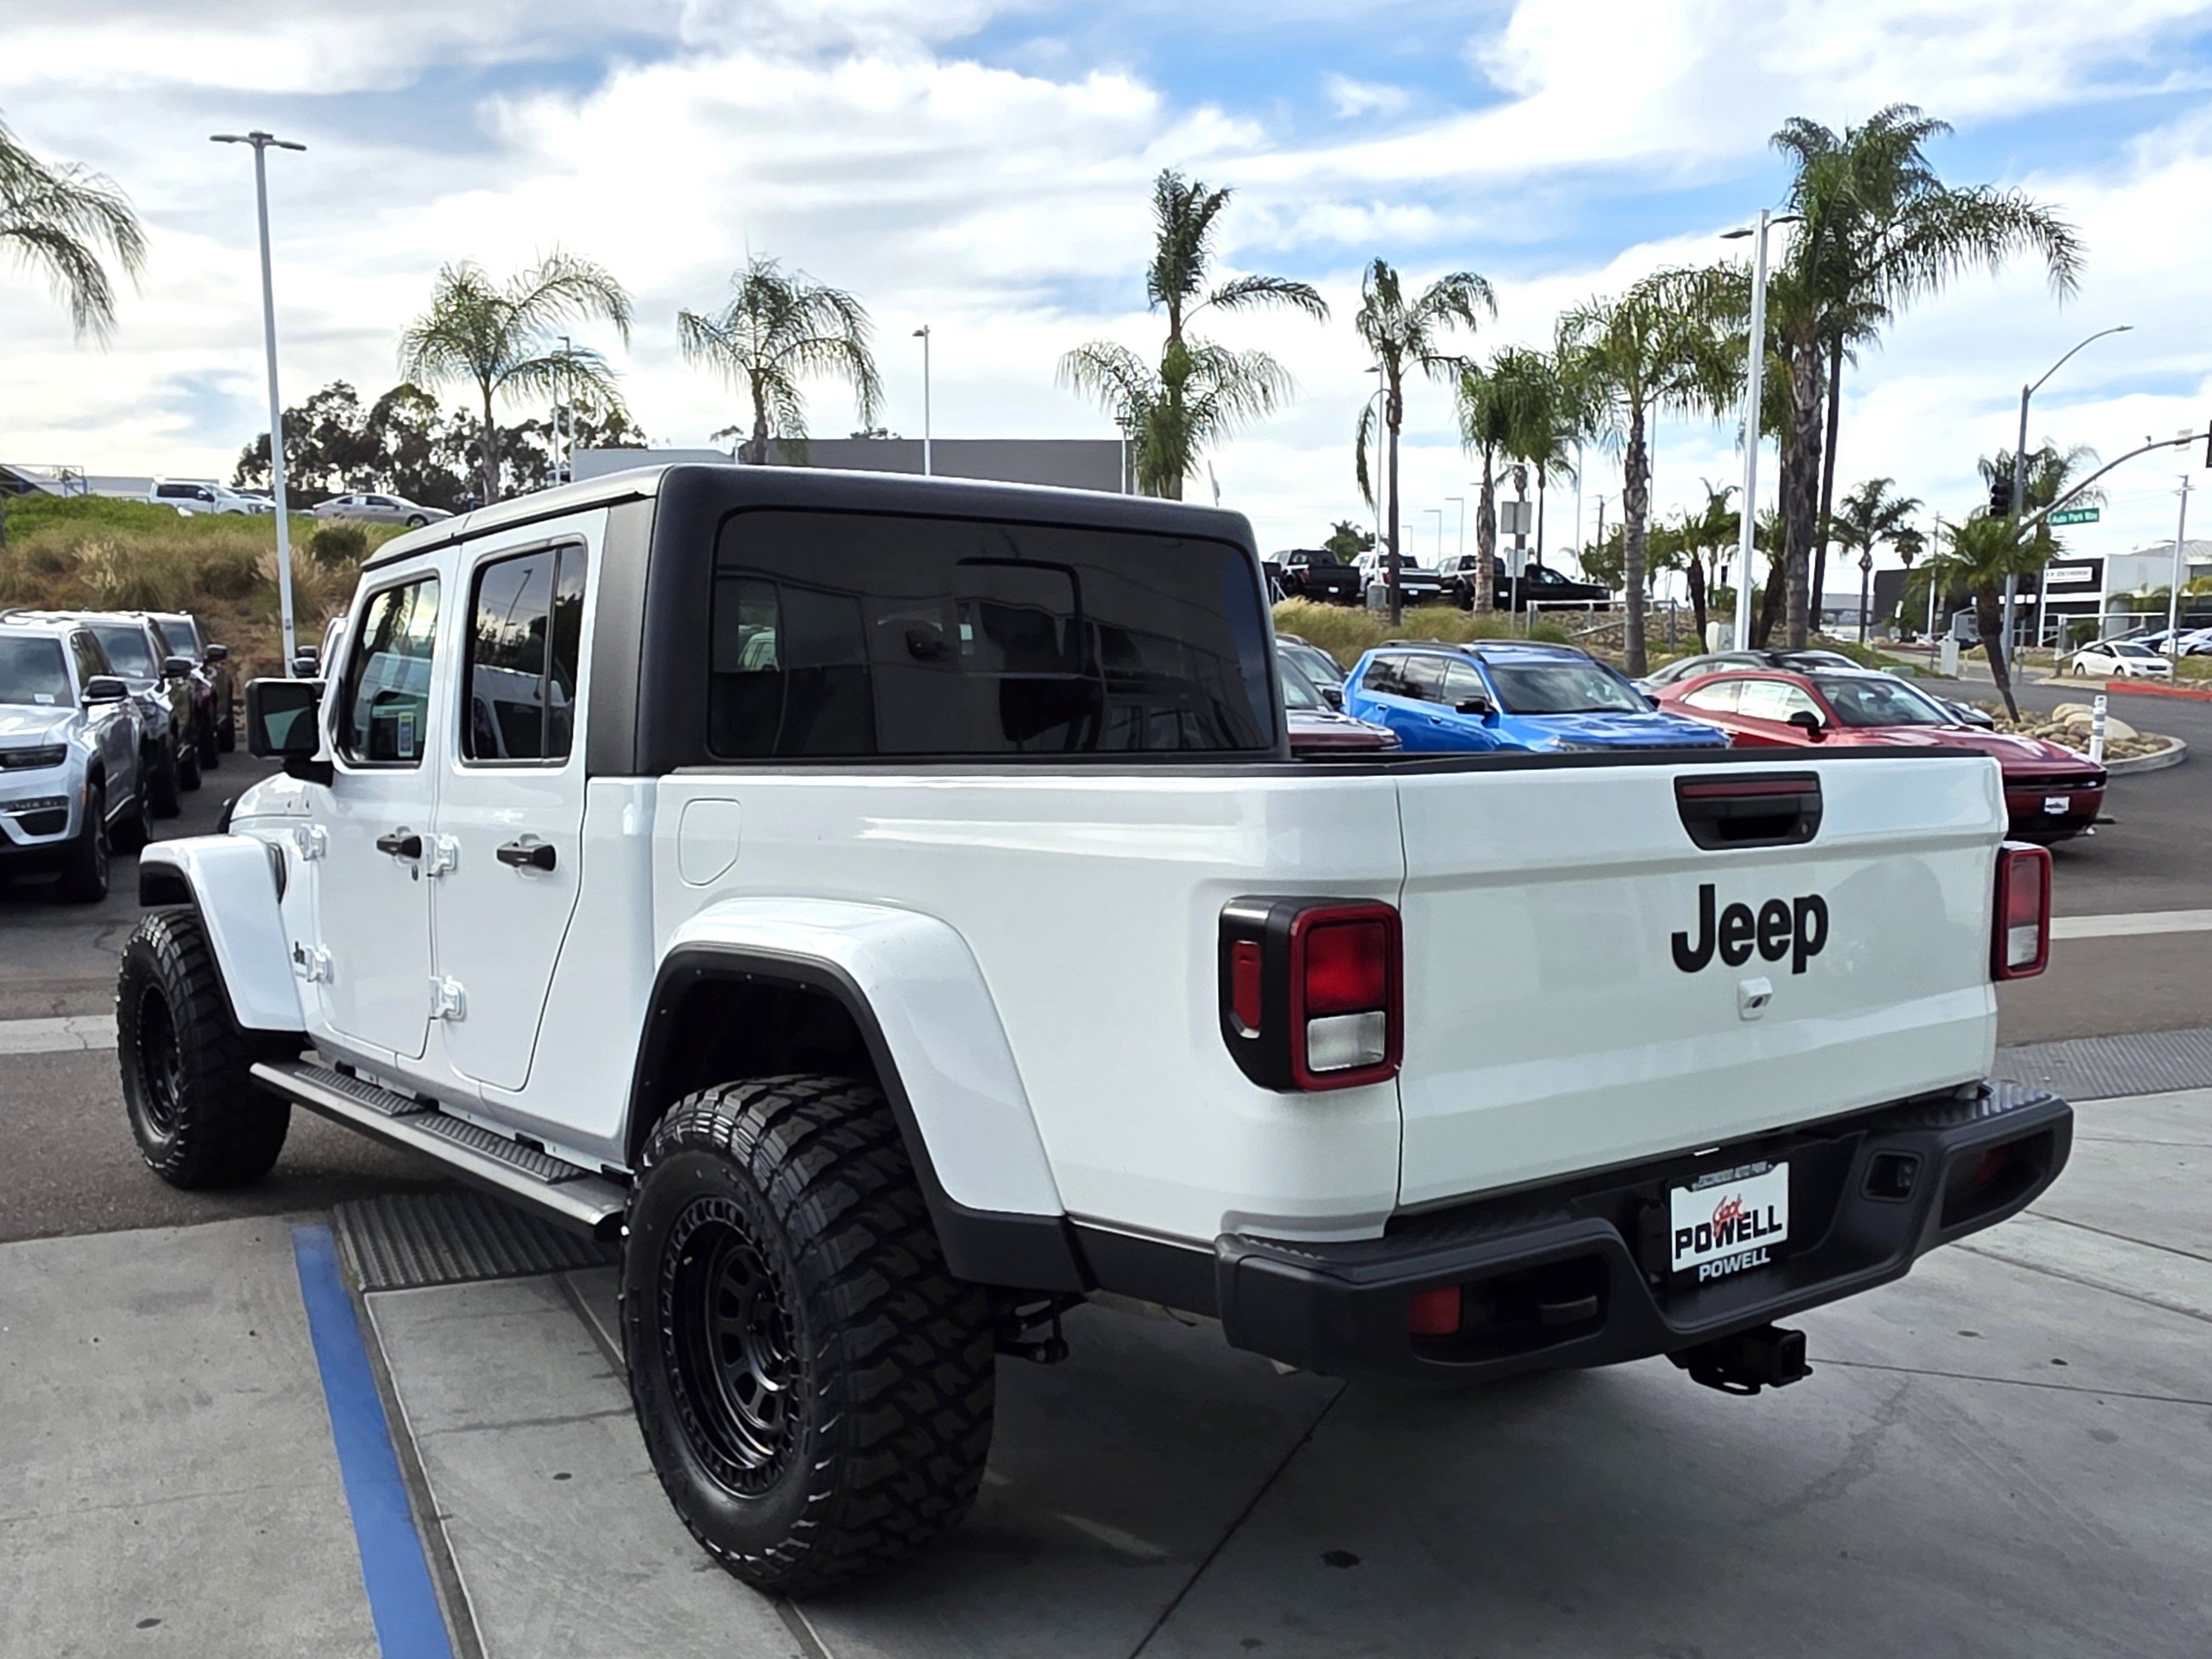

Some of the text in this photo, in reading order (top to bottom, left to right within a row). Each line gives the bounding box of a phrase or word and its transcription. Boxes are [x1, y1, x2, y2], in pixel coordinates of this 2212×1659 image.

[1671, 884, 1829, 975] Jeep
[1675, 1205, 1782, 1259] POWELL
[1699, 1247, 1771, 1282] POWELL
